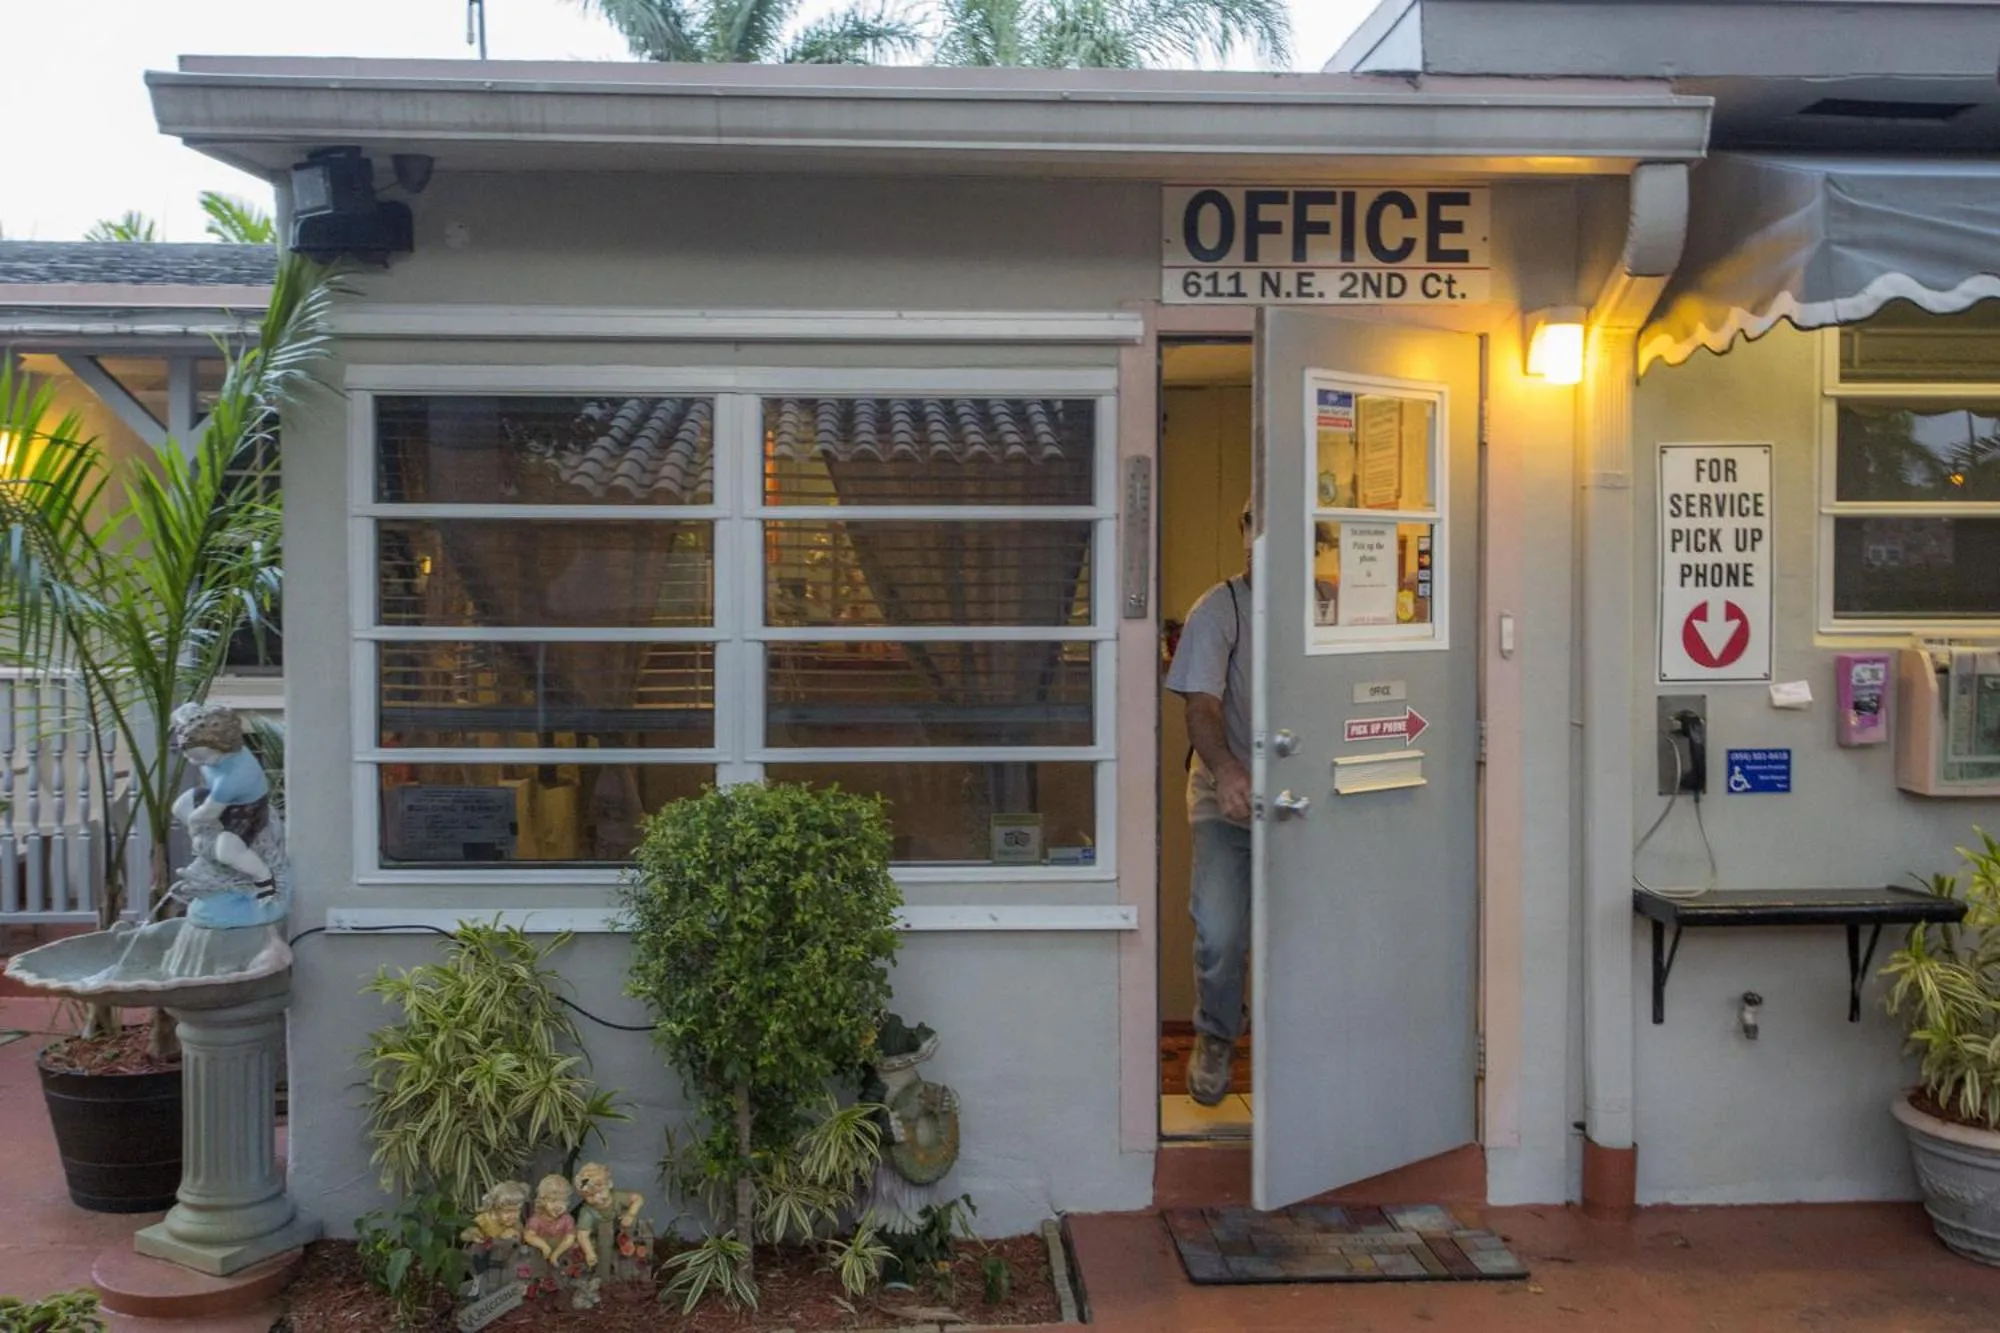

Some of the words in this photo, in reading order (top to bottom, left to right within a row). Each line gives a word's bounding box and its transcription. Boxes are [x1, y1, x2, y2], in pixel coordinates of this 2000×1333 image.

[1182, 189, 1471, 263] OFFICE
[1182, 270, 1248, 298] 611
[1260, 270, 1325, 298] N.E.
[1338, 271, 1408, 299] 2ND
[1421, 272, 1467, 299] Ct.
[1695, 458, 1738, 483] FOR
[1669, 493, 1765, 519] SERVICE
[1671, 528, 1723, 553] PICK
[1734, 527, 1764, 553] UP
[1680, 562, 1755, 588] PHONE
[1350, 723, 1369, 736] PICK
[1370, 722, 1382, 735] UP
[1382, 721, 1407, 734] PHONE
